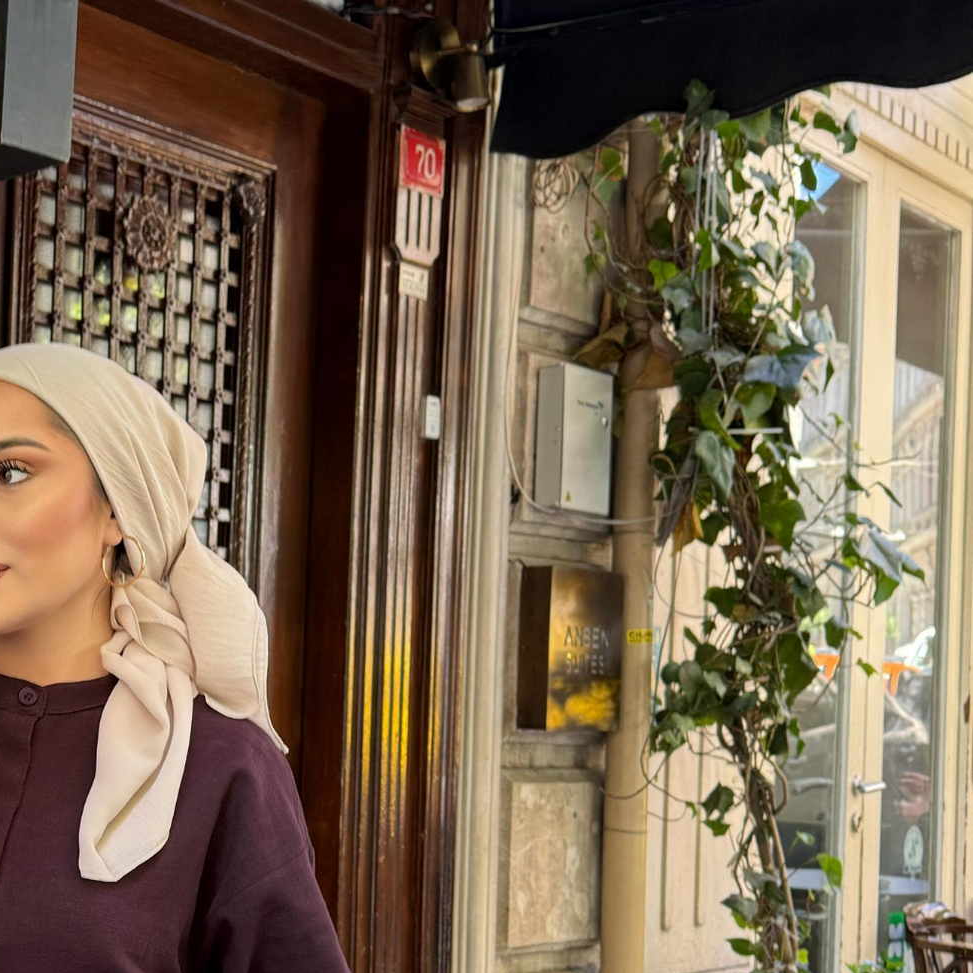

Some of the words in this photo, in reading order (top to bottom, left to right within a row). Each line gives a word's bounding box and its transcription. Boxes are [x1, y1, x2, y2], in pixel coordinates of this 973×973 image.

[415, 143, 437, 180] 70
[563, 625, 610, 650] ANSEN
[564, 651, 606, 676] SUITES
